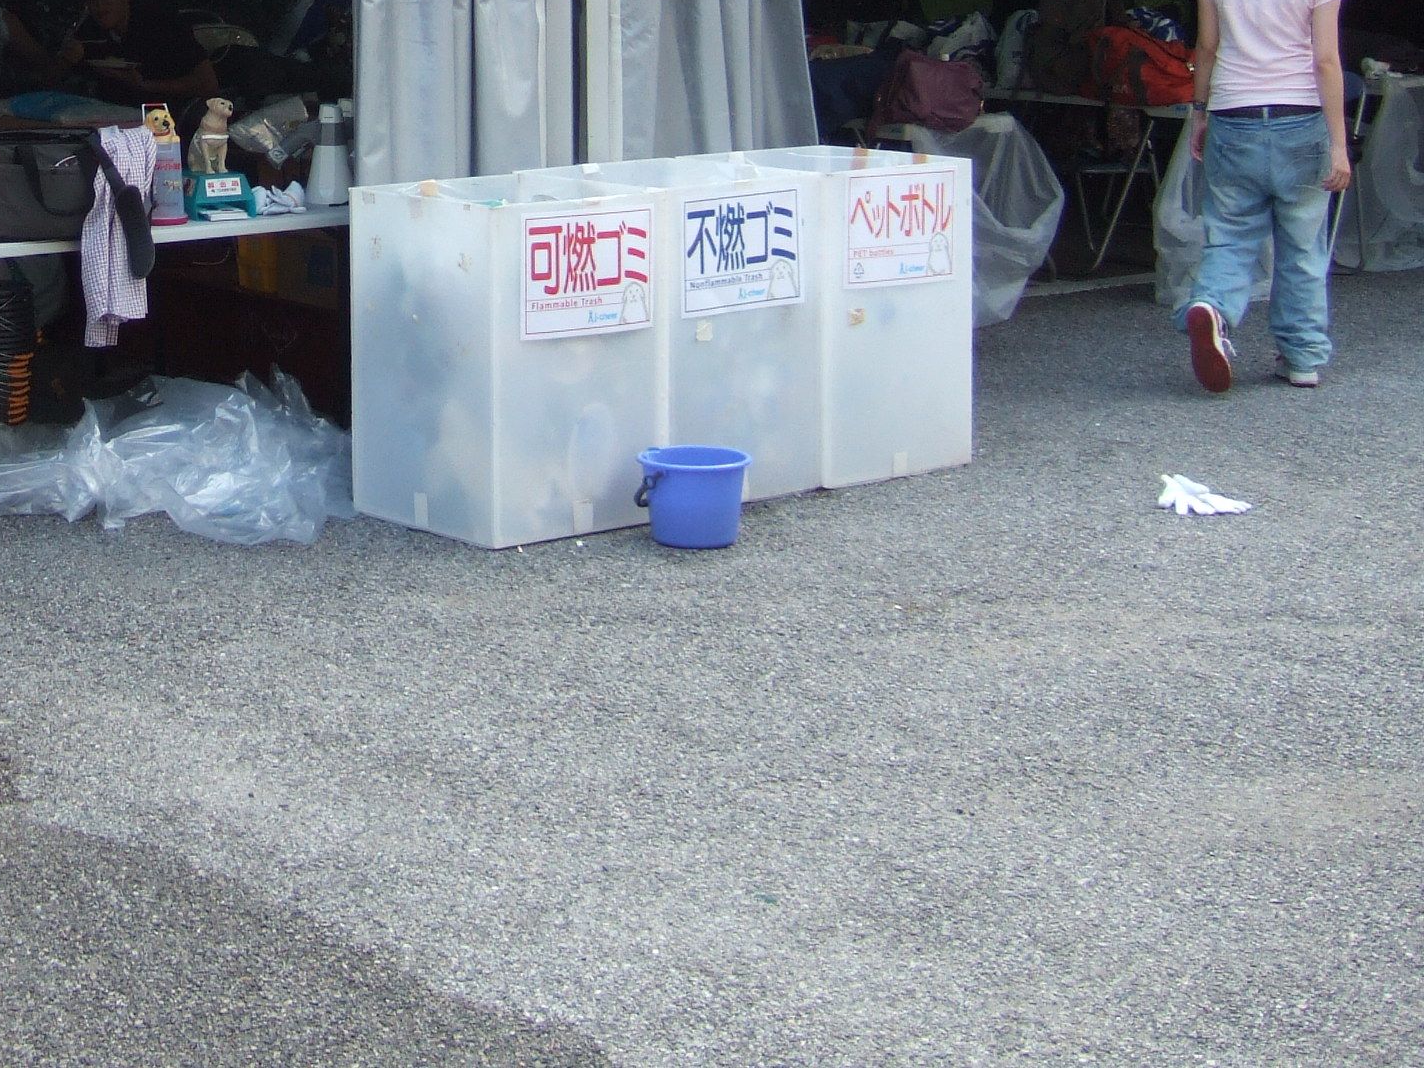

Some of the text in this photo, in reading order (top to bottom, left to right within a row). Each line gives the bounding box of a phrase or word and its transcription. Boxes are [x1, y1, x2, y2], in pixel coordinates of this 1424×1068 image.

[687, 201, 796, 274] 不燃ゴミ
[851, 182, 952, 239] ペットボトル
[529, 220, 648, 294] 可燃ゴミ
[531, 296, 604, 310] Flammable Trash
